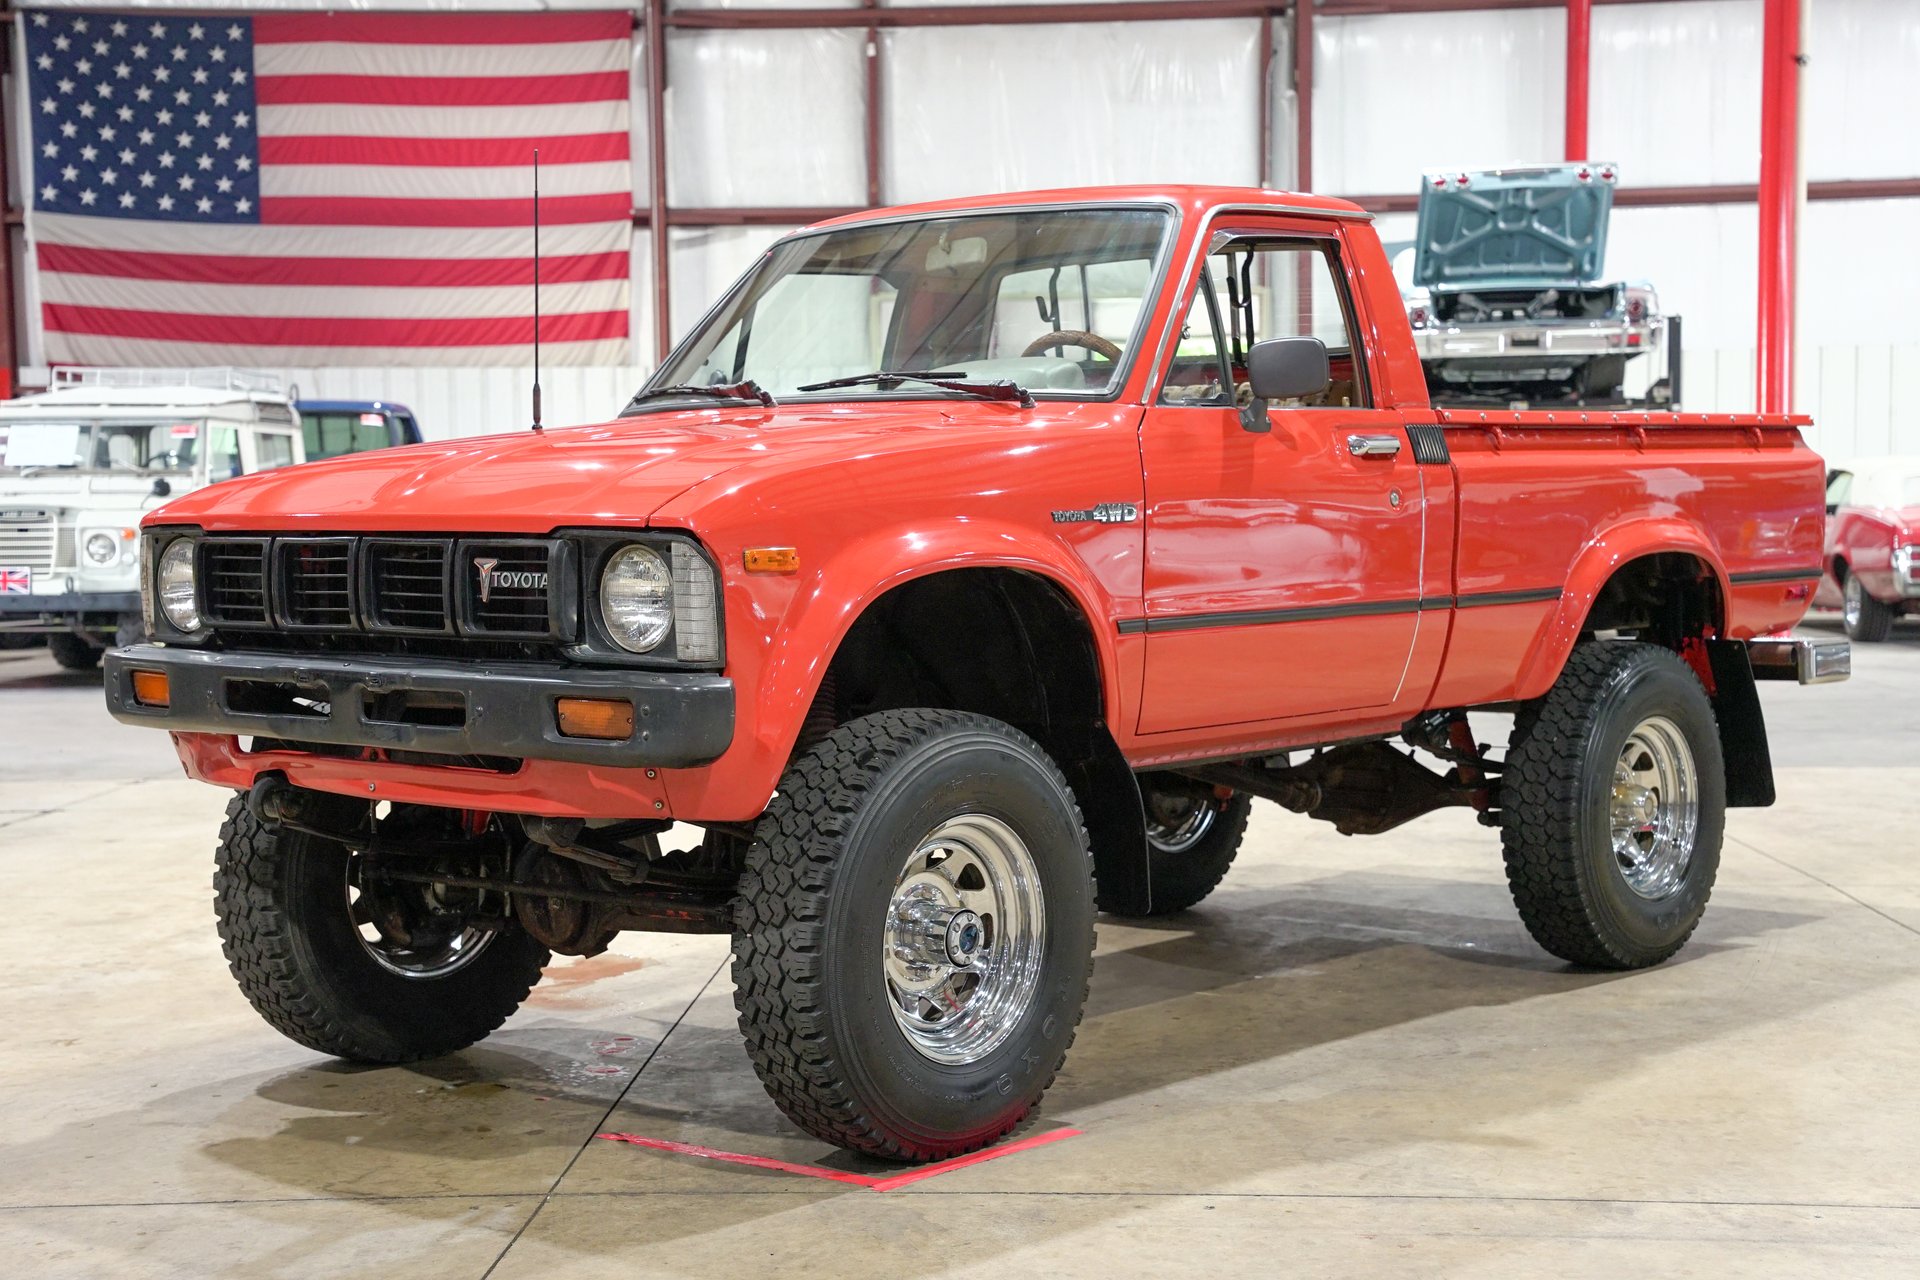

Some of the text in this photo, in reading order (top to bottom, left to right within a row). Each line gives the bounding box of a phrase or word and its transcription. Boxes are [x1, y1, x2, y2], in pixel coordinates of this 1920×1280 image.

[1052, 503, 1137, 522] TOYOTA 4WD
[491, 571, 548, 588] TOYOTA
